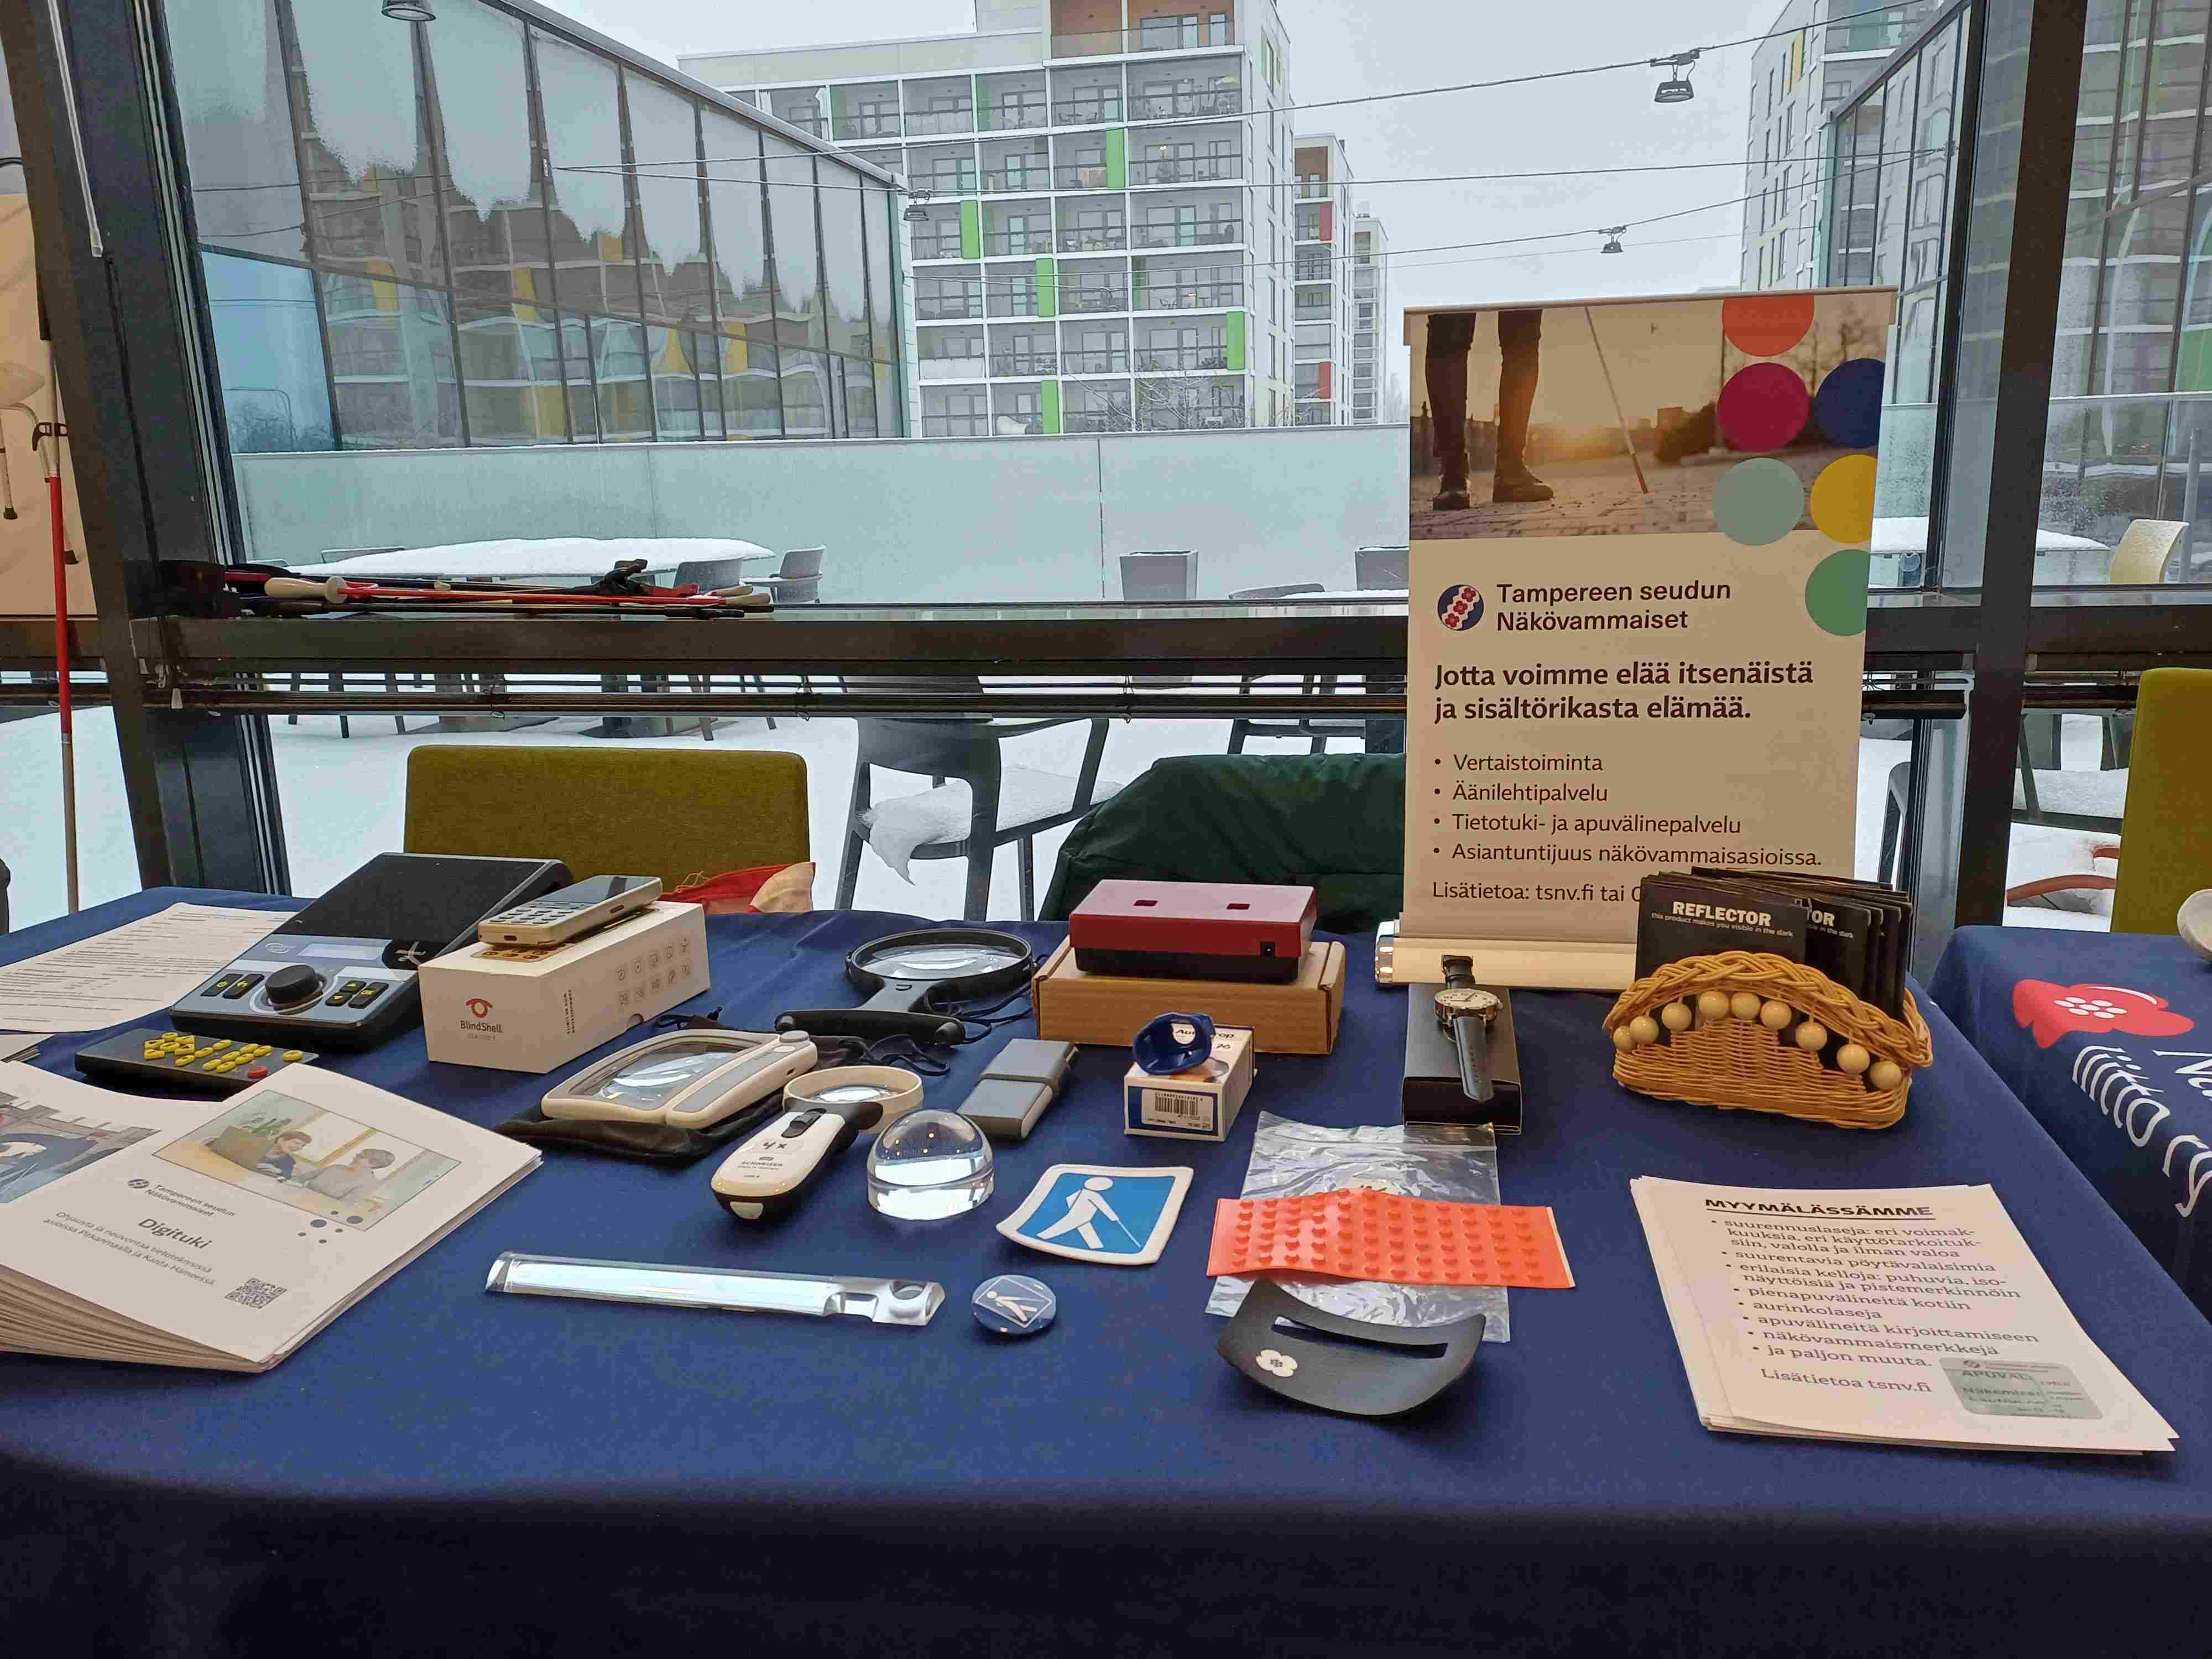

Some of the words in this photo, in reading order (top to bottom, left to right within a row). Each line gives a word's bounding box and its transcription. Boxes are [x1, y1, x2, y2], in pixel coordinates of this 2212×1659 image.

[1497, 584, 1632, 606] Tampereen
[1640, 580, 1730, 600] seudun
[1497, 609, 1688, 631] Näkövammaiset
[1435, 665, 1495, 690] Jotta
[1503, 664, 1608, 685] voimme
[1616, 661, 1670, 684] elää
[1679, 661, 1813, 684] itsenäistä
[1434, 697, 1457, 724] ja
[1464, 696, 1639, 719] sisältörikasta
[1647, 695, 1751, 718] elämää.
[1453, 754, 1603, 770] Vertaistoiminta
[1452, 780, 1608, 805] Äänilehtipalvelu
[1452, 813, 1546, 830] Tietotuki-
[1551, 815, 1568, 835] ja
[1574, 814, 1741, 836] apuvälinepalvelu
[1452, 843, 1592, 864] Asiantuntijuus
[1599, 844, 1822, 866] näkövammaisasioissa.
[1433, 881, 1529, 899] Lisätietoa:
[1536, 884, 1593, 901] tsnv.fi
[1600, 885, 1624, 901] tai
[1651, 912, 1664, 920] this
[1665, 915, 1691, 925] product
[1693, 918, 1715, 927] makes
[1716, 922, 1730, 930] you
[1731, 923, 1754, 933] visible
[1776, 928, 1794, 938] dark
[1672, 901, 1772, 927] REFLECTOR
[460, 1020, 503, 1033] BlindShell
[154, 1185, 202, 1205] Tampereen
[203, 1202, 235, 1217] seudun
[1705, 1199, 1932, 1215] MYYMÄLÄSSÄMME
[138, 1218, 212, 1249] Digituki
[1725, 1220, 1870, 1236] suurennuslaseja:
[1875, 1228, 1898, 1236] eri
[1902, 1228, 1975, 1237] voimak-
[1771, 1241, 1829, 1253] valolla
[1834, 1244, 1849, 1255] ja
[1853, 1246, 1906, 1256] ilman
[1910, 1249, 1960, 1258] valoa
[1805, 1234, 1827, 1243] eri
[1832, 1234, 1981, 1248] käyttötarkoituk-
[1736, 1251, 1847, 1266] suurentavia
[1848, 1258, 1996, 1272] pöytävalaisimia
[1740, 1264, 1812, 1276] erilaisia
[1817, 1269, 1881, 1281] kelloja:
[1973, 1276, 2006, 1286] iso-
[1743, 1274, 1835, 1288] näyttöisiä
[1840, 1280, 1855, 1291] ja
[1861, 1283, 2021, 1298] pistemerkinnöin
[1749, 1287, 1907, 1307] pienapuvälineitä
[1912, 1297, 1972, 1310] kotiin
[1753, 1302, 1882, 1319] aurinkolaseja
[1758, 1316, 1880, 1333] apuvälineitä
[1884, 1324, 2039, 1343] kirjoittamiseen
[1764, 1331, 2000, 1357] näkövammaismerkkejä
[1767, 1344, 1785, 1356] ja
[1790, 1348, 1854, 1363] paljon
[1859, 1354, 1932, 1367] muuta.
[1760, 1368, 1864, 1388] Lisätietoa
[1868, 1379, 1933, 1392] tsnv.fi
